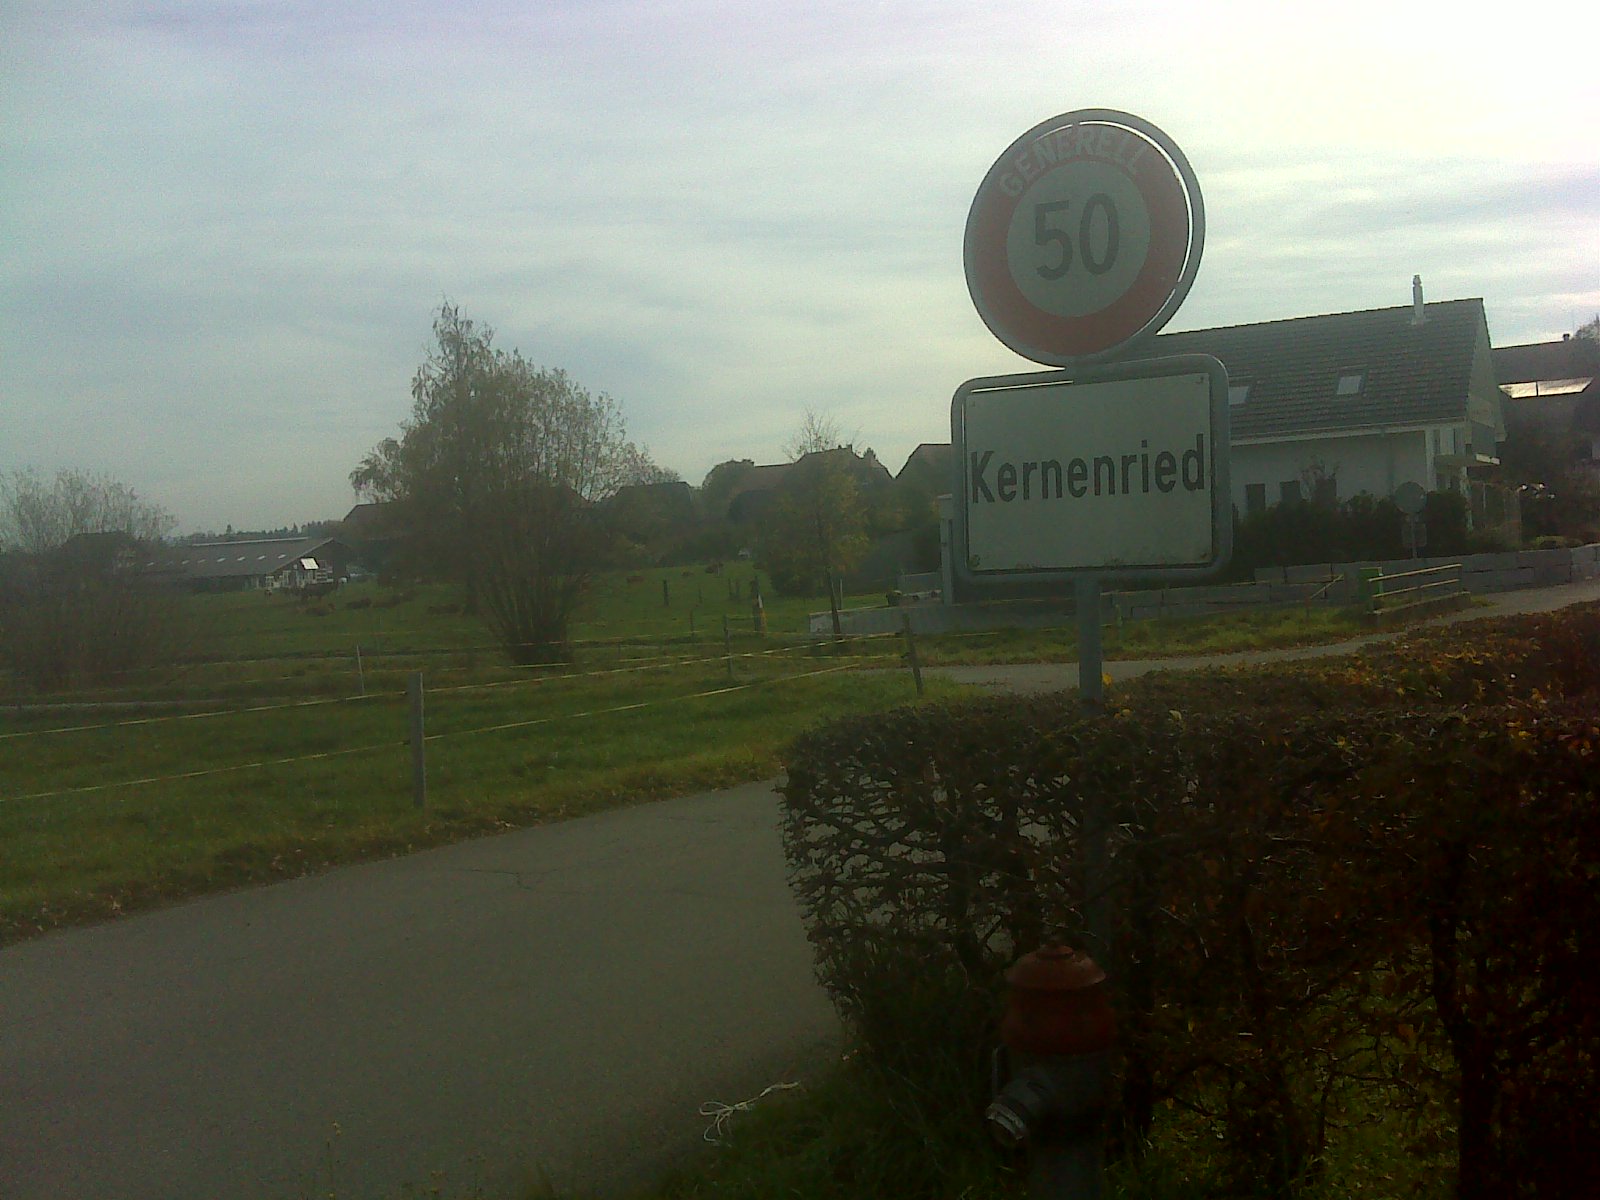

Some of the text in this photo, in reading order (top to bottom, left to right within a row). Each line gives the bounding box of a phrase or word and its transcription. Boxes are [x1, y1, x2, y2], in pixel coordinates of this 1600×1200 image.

[1000, 126, 1149, 195] GENERELL
[1034, 193, 1119, 280] 50
[970, 433, 1205, 504] Kernenried
